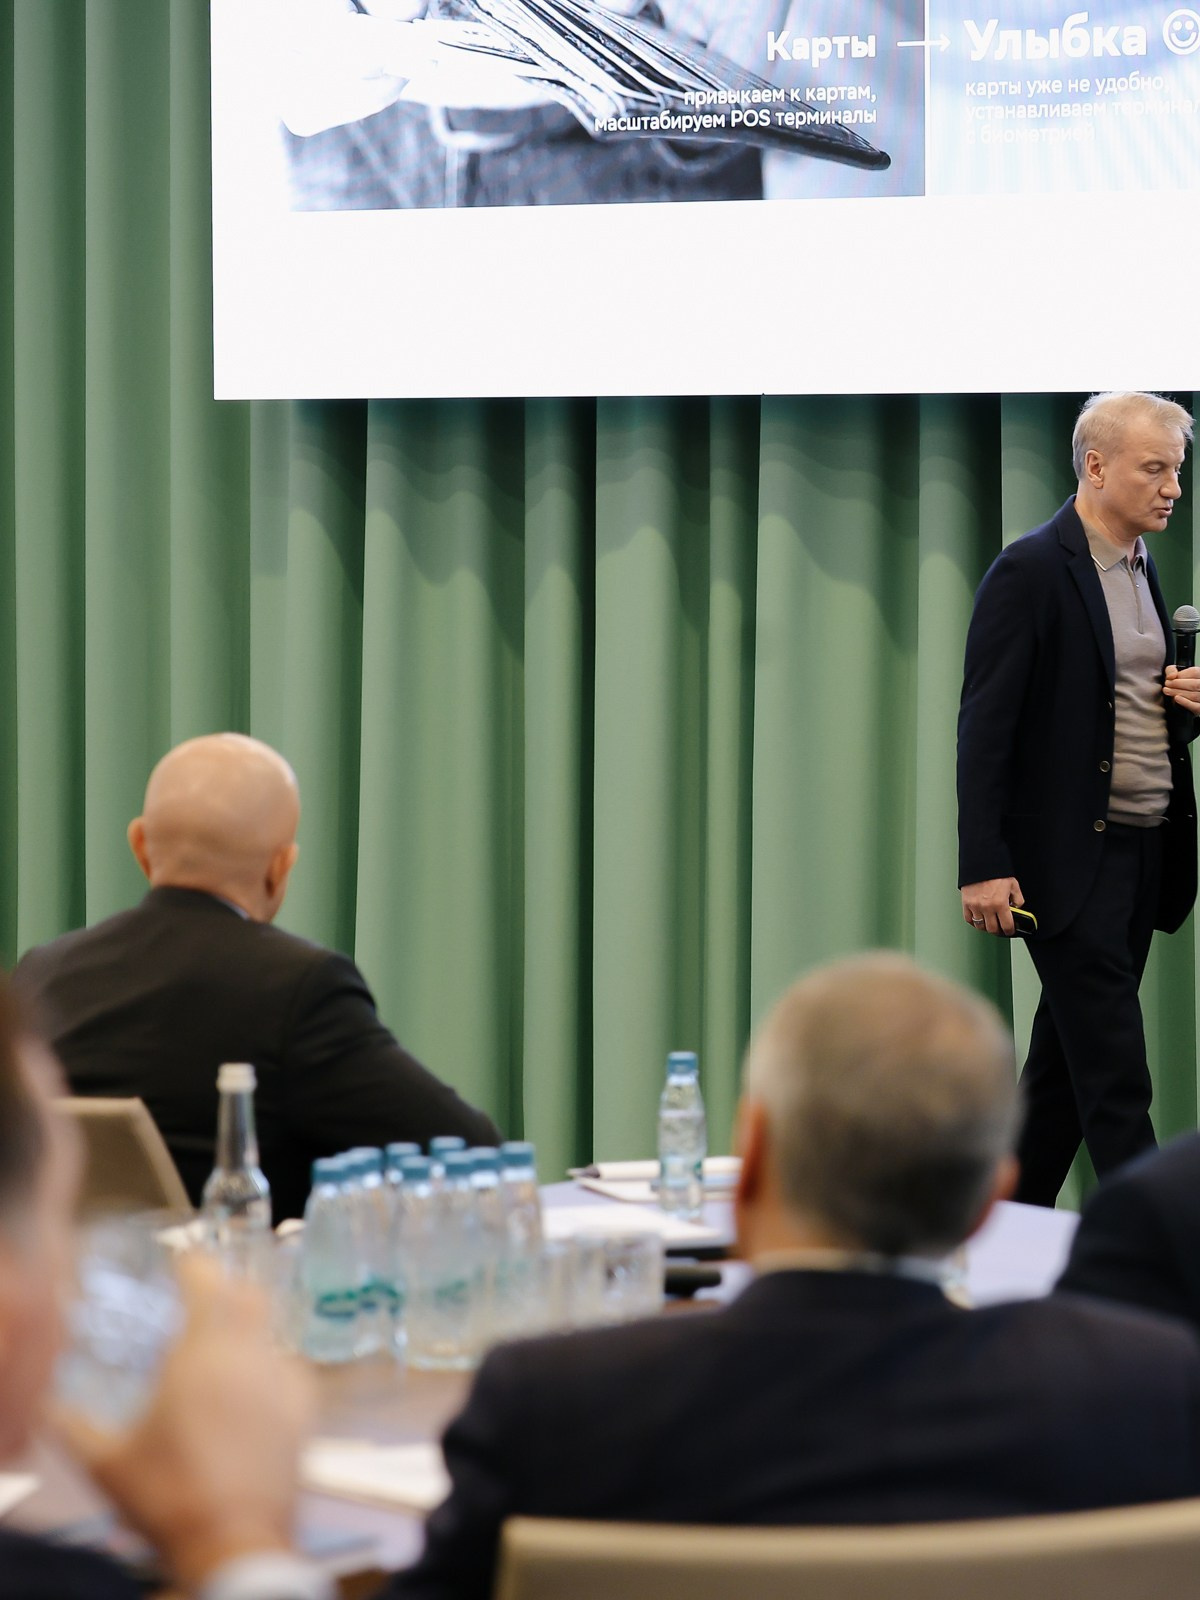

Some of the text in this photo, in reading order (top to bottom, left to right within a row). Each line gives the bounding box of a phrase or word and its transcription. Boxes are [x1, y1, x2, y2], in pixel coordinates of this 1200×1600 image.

[963, 11, 1147, 61] Улыбка
[766, 31, 876, 68] Карты
[684, 85, 876, 108] привыкаем к картам,
[965, 79, 1022, 99] карты
[1027, 78, 1062, 98] уже
[1068, 77, 1090, 93] не
[594, 109, 877, 133] масштабируем POS терминалы
[965, 101, 1106, 123] устанавливаем
